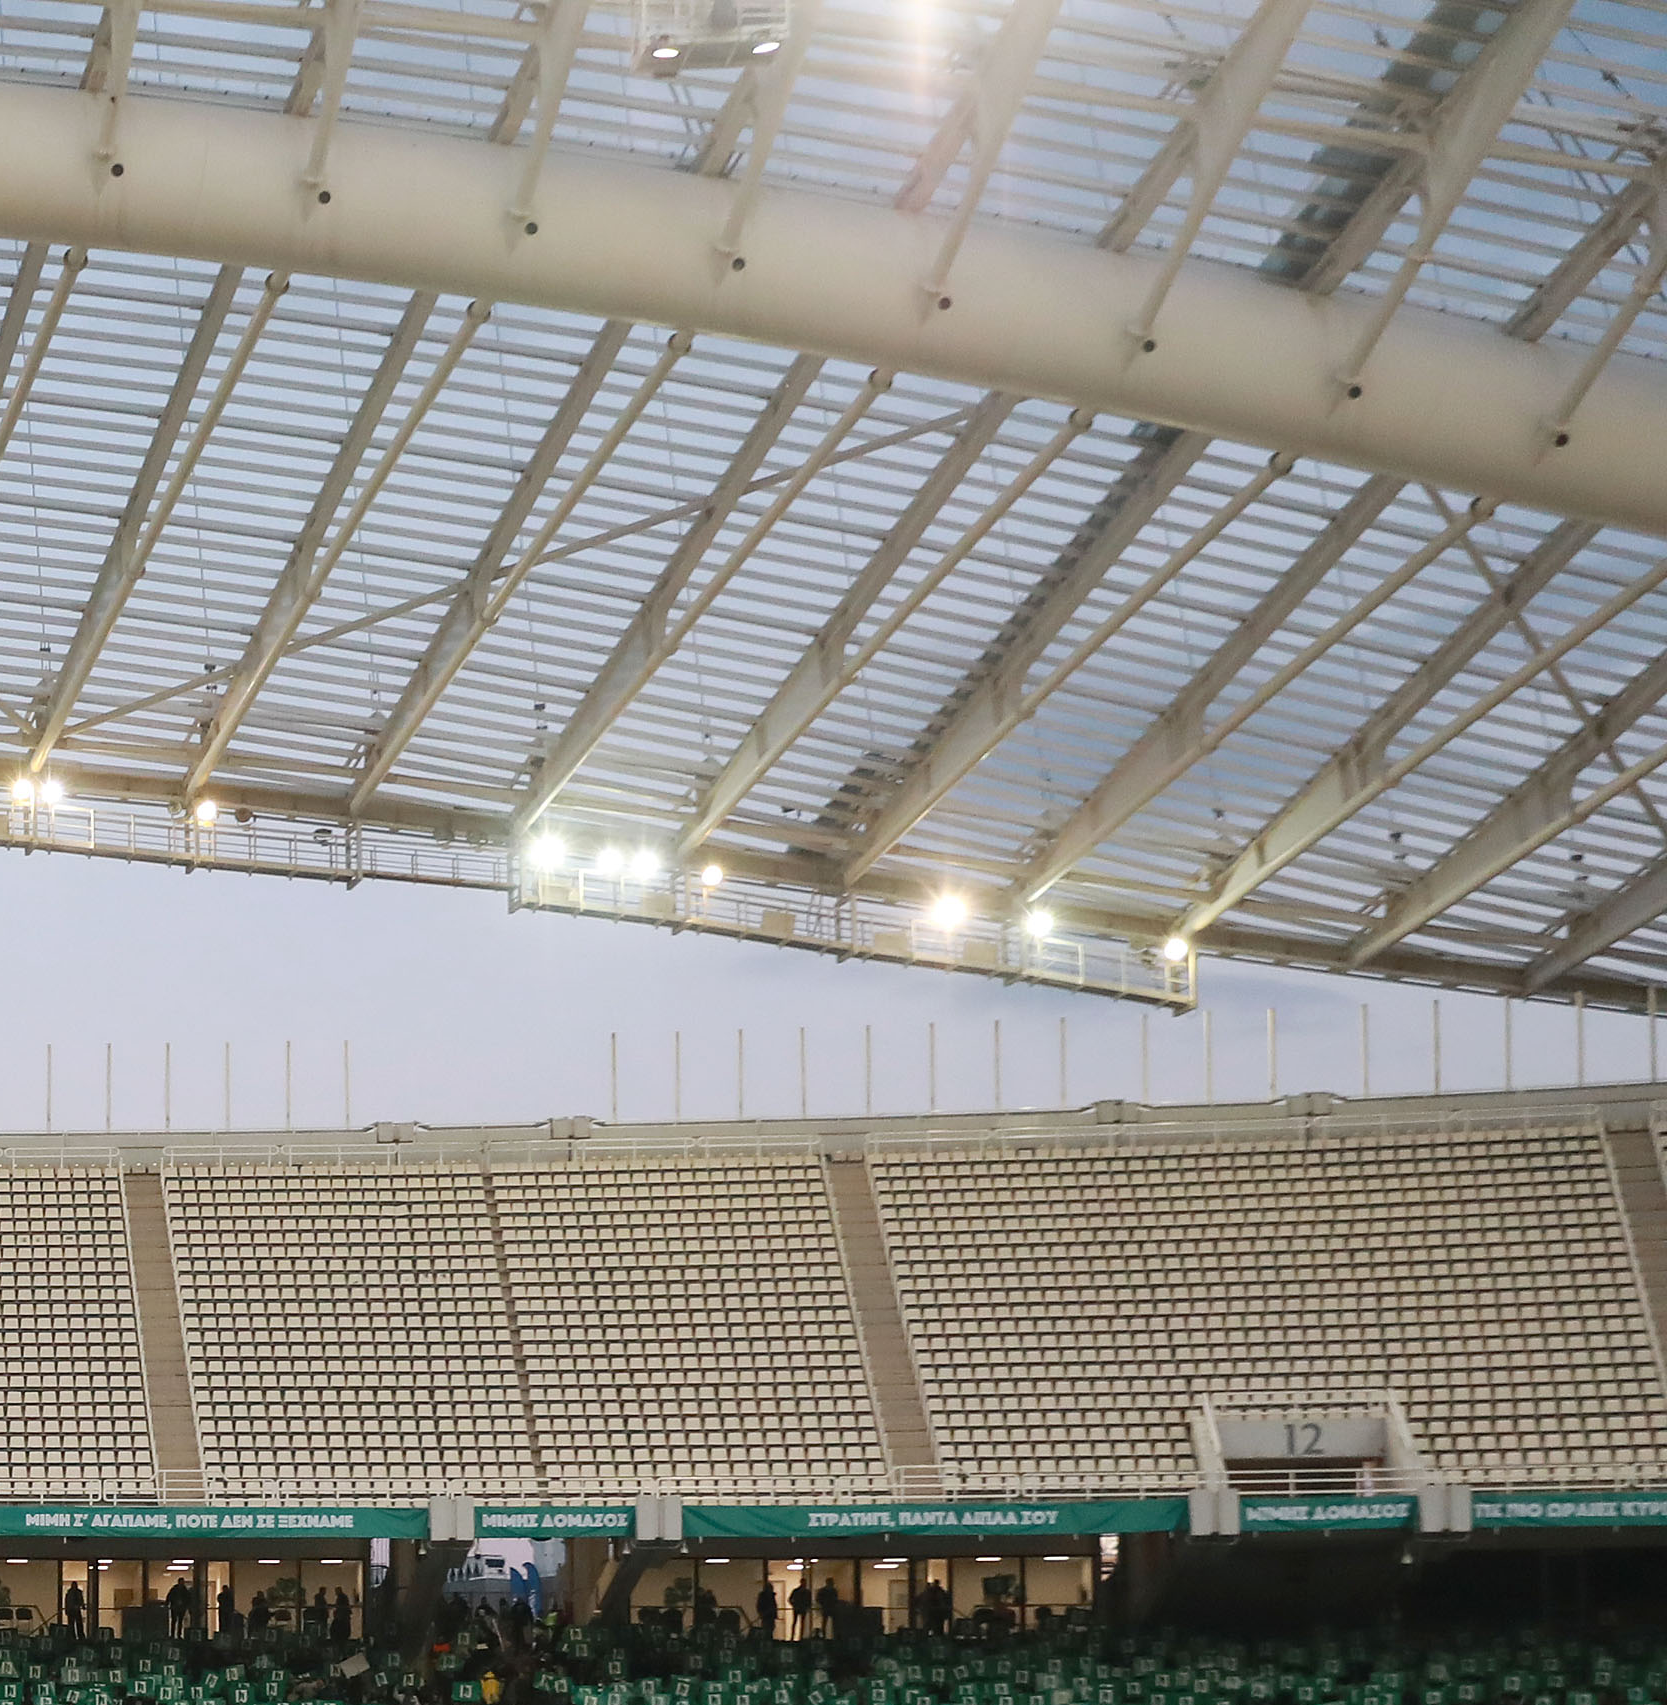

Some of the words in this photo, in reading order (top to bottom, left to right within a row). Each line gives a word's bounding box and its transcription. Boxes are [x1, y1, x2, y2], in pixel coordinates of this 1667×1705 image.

[1282, 1422, 1323, 1457] 12
[25, 1514, 70, 1527] ΜΙΜΗ
[175, 1514, 218, 1528] ΠΟΤΕ
[220, 1515, 254, 1528] ΔΕΝ
[256, 1515, 275, 1528] ΣΕ
[278, 1515, 354, 1528] ΞΕΧΝΑΜΕ
[482, 1514, 538, 1528] ΜΙΜΗΣ
[541, 1514, 628, 1528] ΔΟΜΑΖΟΣ
[899, 1512, 958, 1525] ΠΑΝΤΑ
[1021, 1511, 1059, 1525] ΣΟΥ
